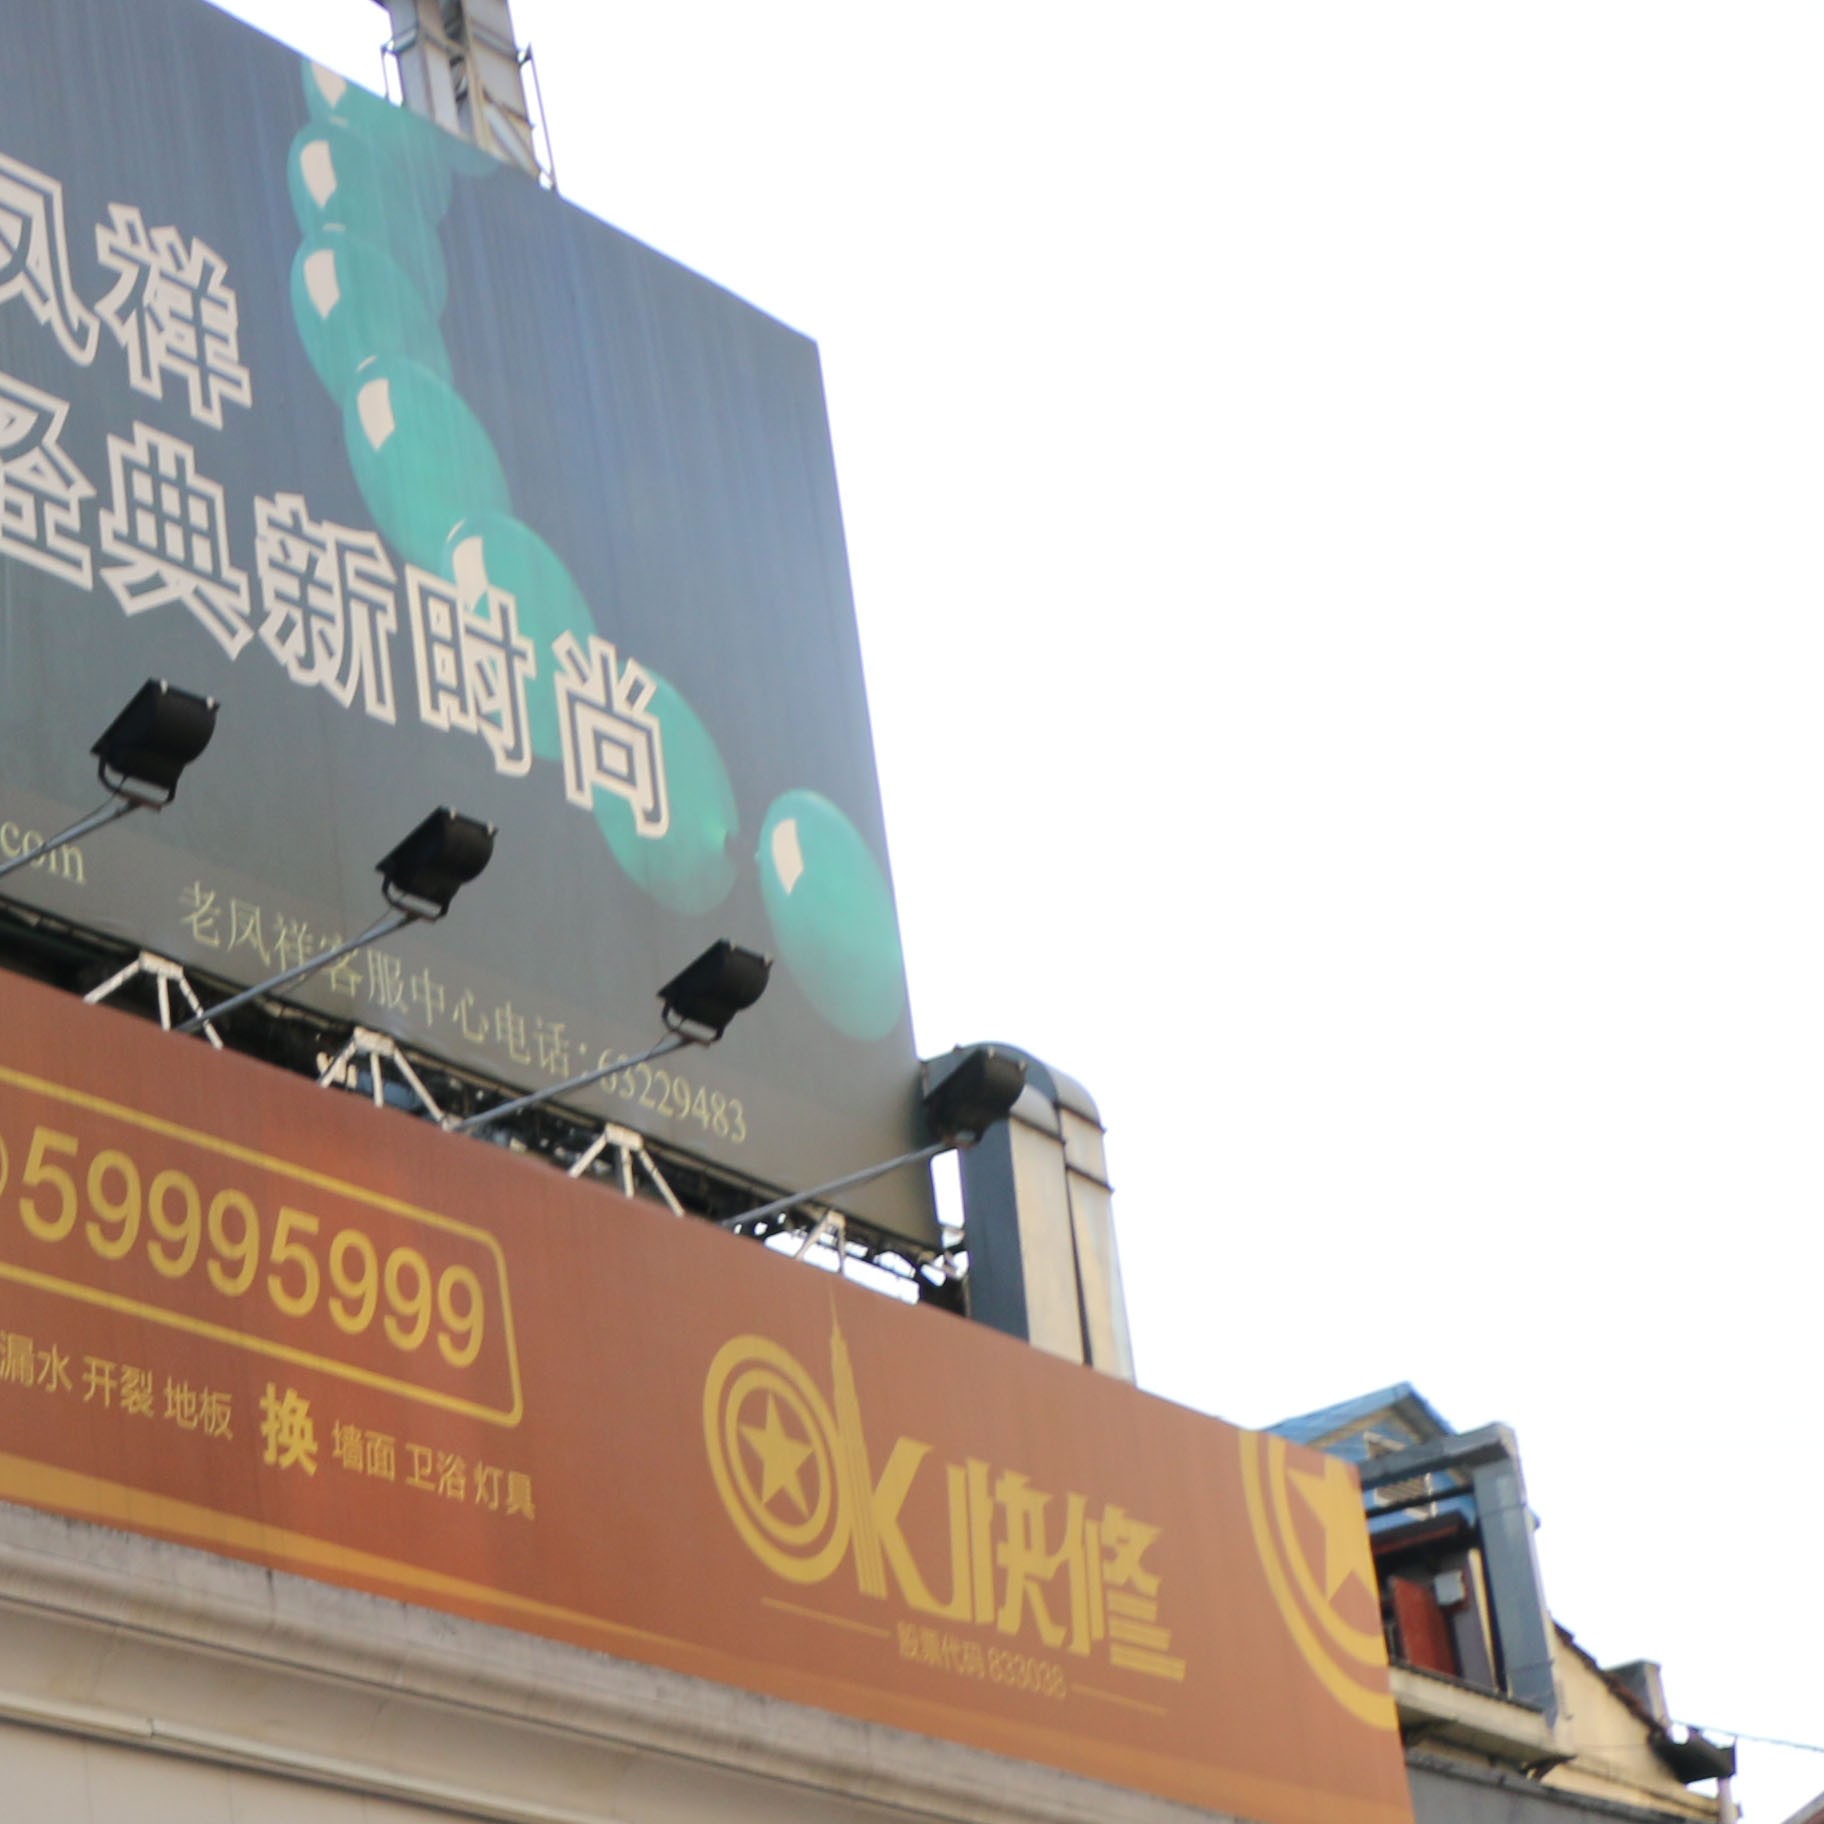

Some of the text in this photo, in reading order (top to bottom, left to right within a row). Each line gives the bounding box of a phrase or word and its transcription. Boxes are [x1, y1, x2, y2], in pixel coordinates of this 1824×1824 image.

[19, 1126, 486, 1369] 59995999
[81, 1355, 156, 1418] 开裂
[162, 1376, 234, 1442] 地板
[258, 1382, 320, 1476] 换
[330, 1419, 397, 1483] 墙面
[404, 1441, 467, 1501] 卫浴
[473, 1460, 537, 1520] 灯具
[987, 1645, 1069, 1700] 833038
